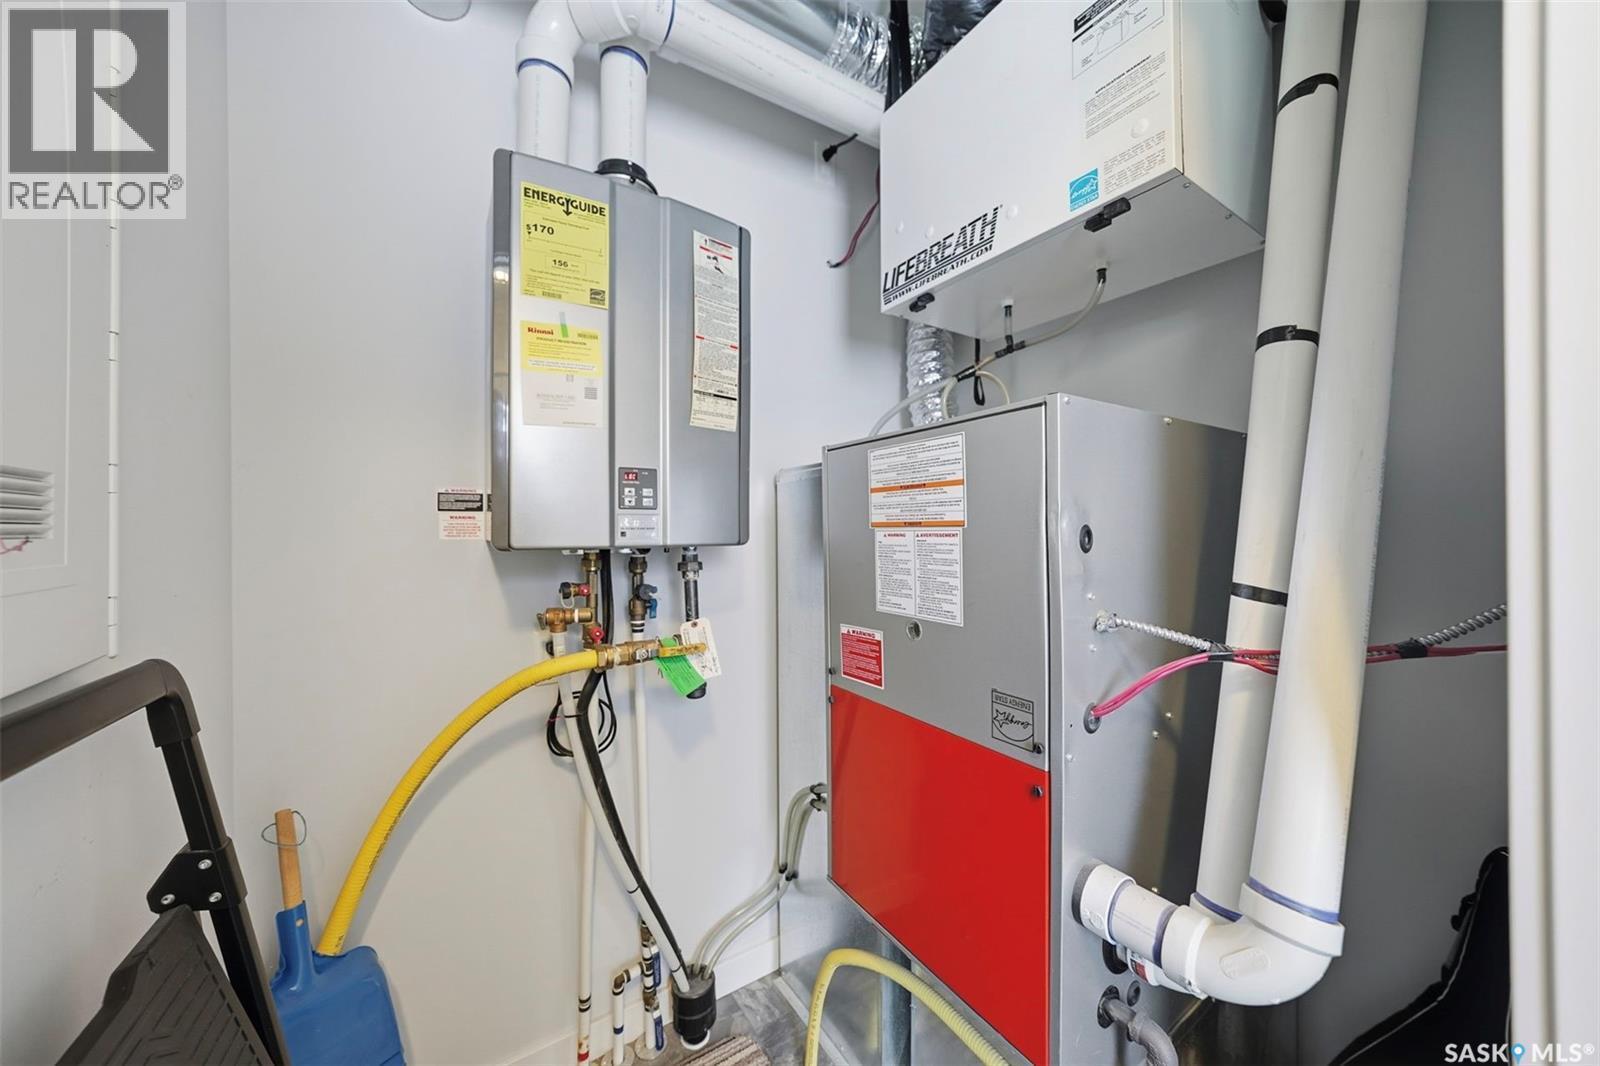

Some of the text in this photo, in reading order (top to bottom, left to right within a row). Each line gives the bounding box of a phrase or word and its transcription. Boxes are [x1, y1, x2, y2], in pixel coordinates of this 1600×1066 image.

[523, 186, 607, 217] ENERGYGUIDE
[882, 206, 999, 295] LIFEBREATH
[527, 326, 554, 336] Rinnai
